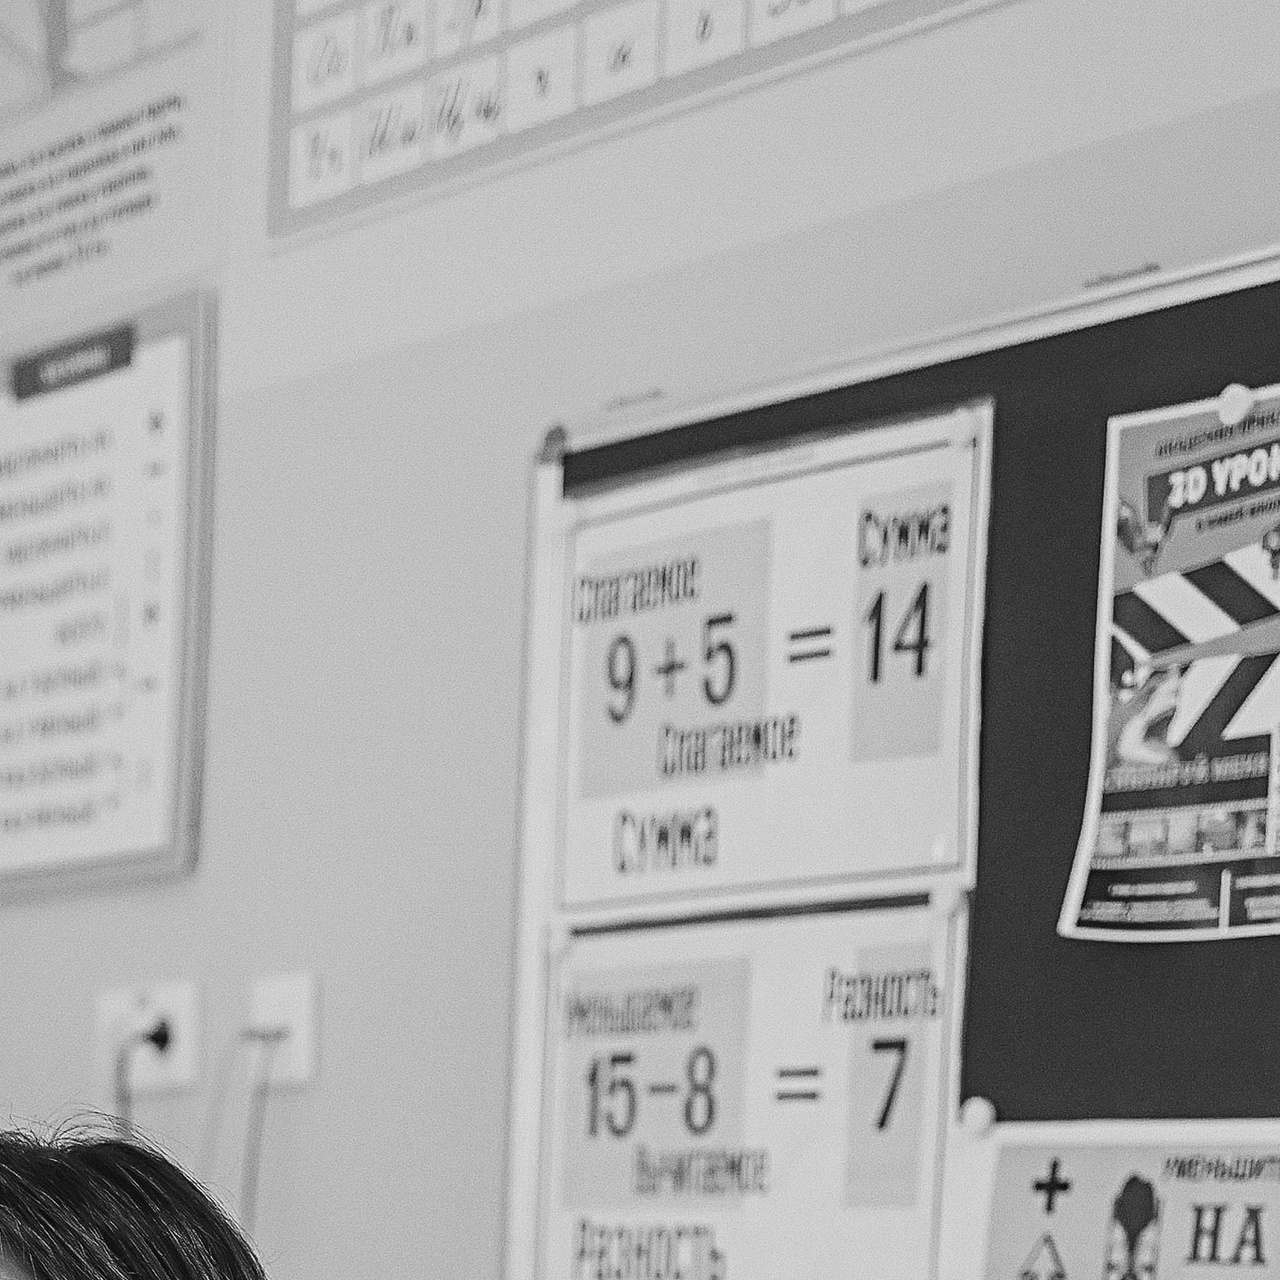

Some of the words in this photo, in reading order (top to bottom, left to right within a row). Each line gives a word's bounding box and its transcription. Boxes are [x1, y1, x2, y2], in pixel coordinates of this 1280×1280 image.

[867, 581, 931, 684] 14
[871, 1037, 908, 1130] 7
[1186, 1203, 1267, 1265] НА
